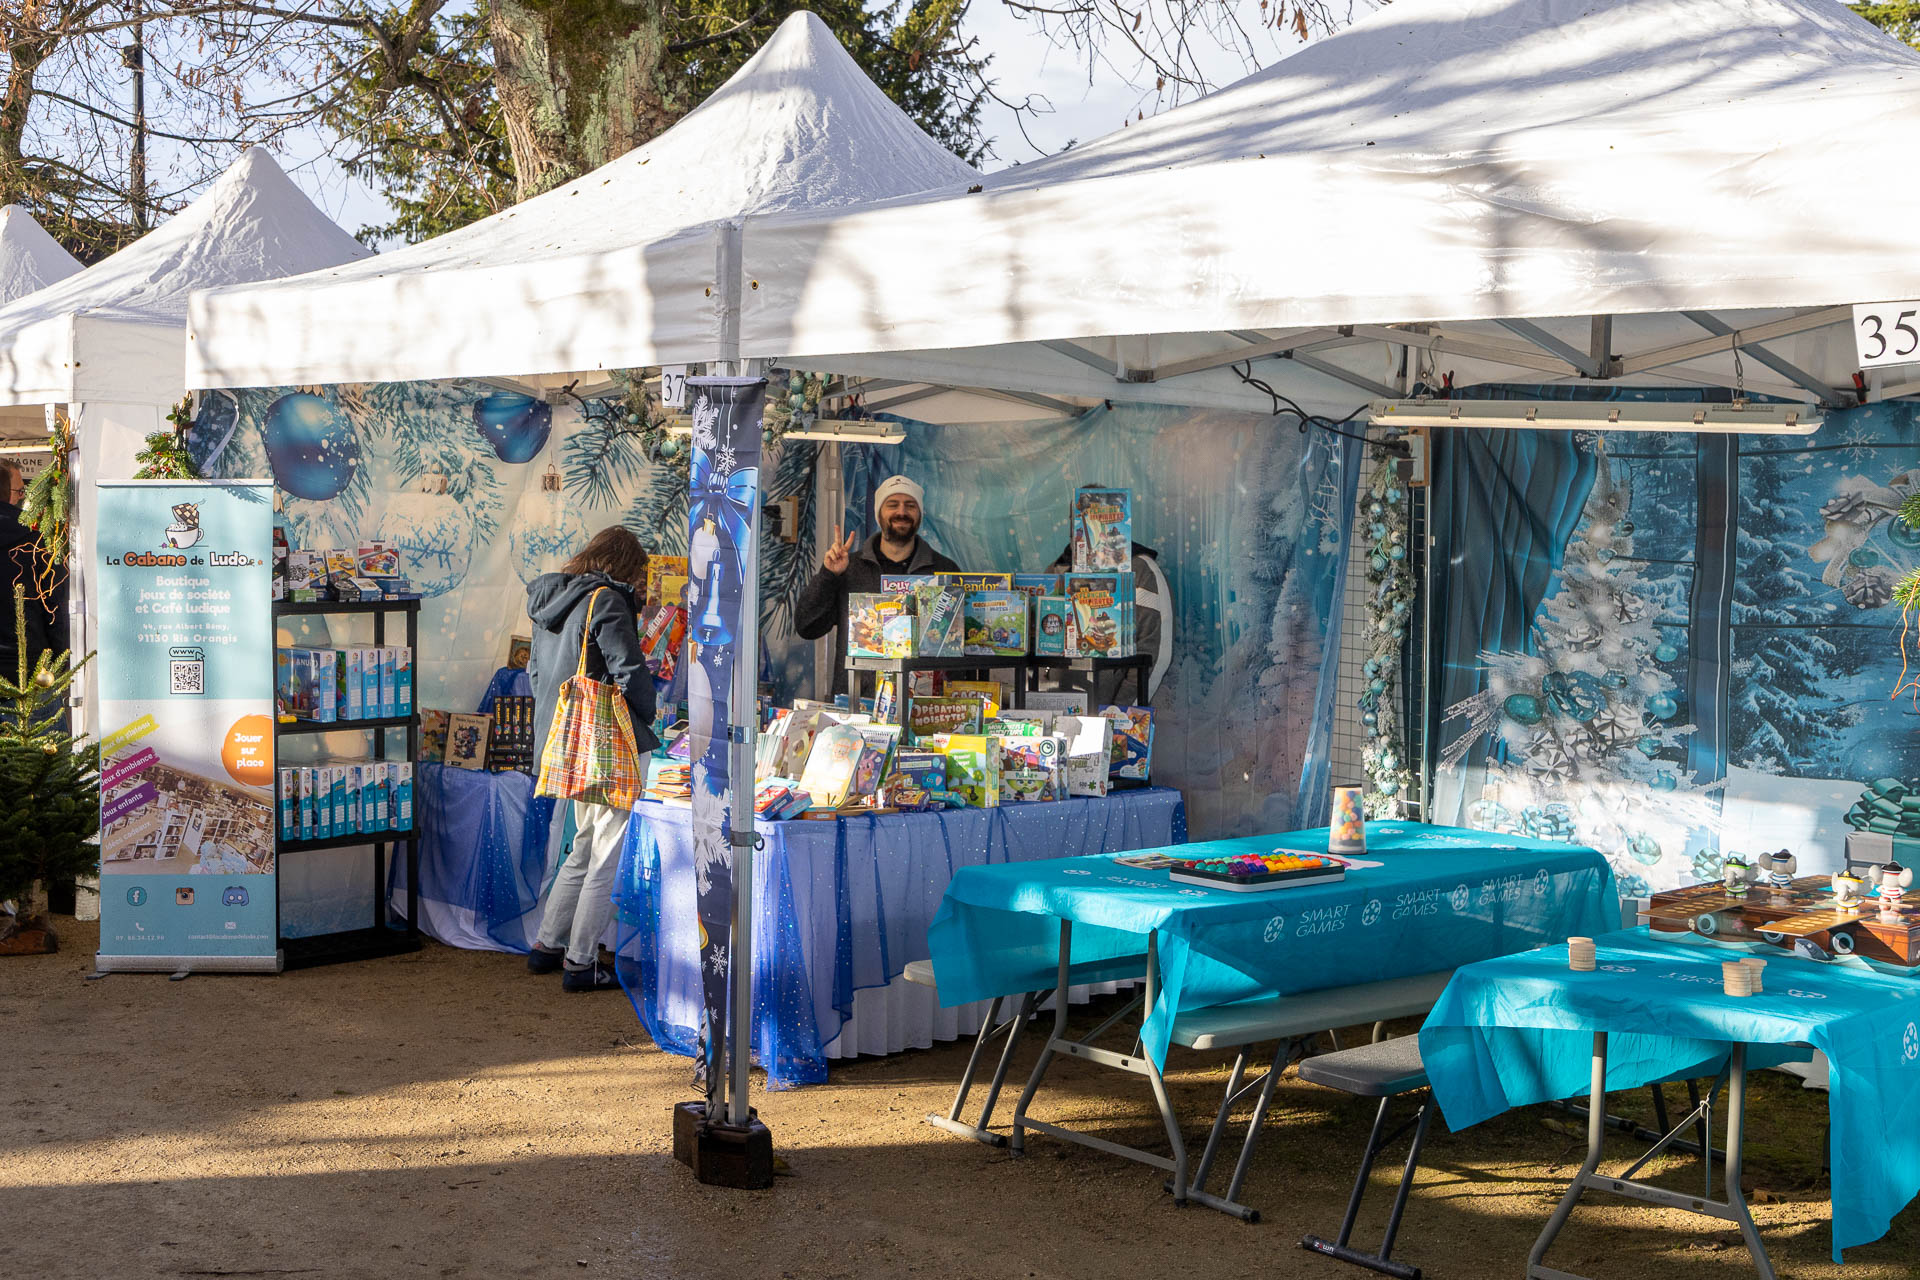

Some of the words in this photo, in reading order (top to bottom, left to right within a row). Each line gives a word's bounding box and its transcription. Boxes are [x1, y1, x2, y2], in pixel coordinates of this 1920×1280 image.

[1861, 310, 1919, 359] 35
[664, 373, 685, 402] 37
[107, 556, 120, 565] La
[124, 551, 187, 567] Cabane
[190, 555, 204, 565] de
[156, 575, 210, 589] Boutique
[952, 577, 999, 592] lendor
[169, 589, 184, 600] de
[187, 589, 231, 600] société
[135, 604, 149, 614] et
[152, 602, 183, 614] Café
[186, 602, 231, 616] ludique
[193, 634, 237, 644] Orangis
[914, 713, 966, 727] NOISETTES
[234, 733, 263, 742] Jouer
[115, 752, 153, 778] d'ambiance
[236, 758, 264, 769] place
[102, 807, 117, 820] Jeux
[118, 792, 144, 811] enfants
[1481, 873, 1523, 893] SMART
[1395, 889, 1441, 907] SMART
[1479, 888, 1521, 906] GAMES
[1300, 904, 1351, 924] SMART
[1392, 903, 1438, 920] GAMES
[1296, 918, 1346, 937] GAMES
